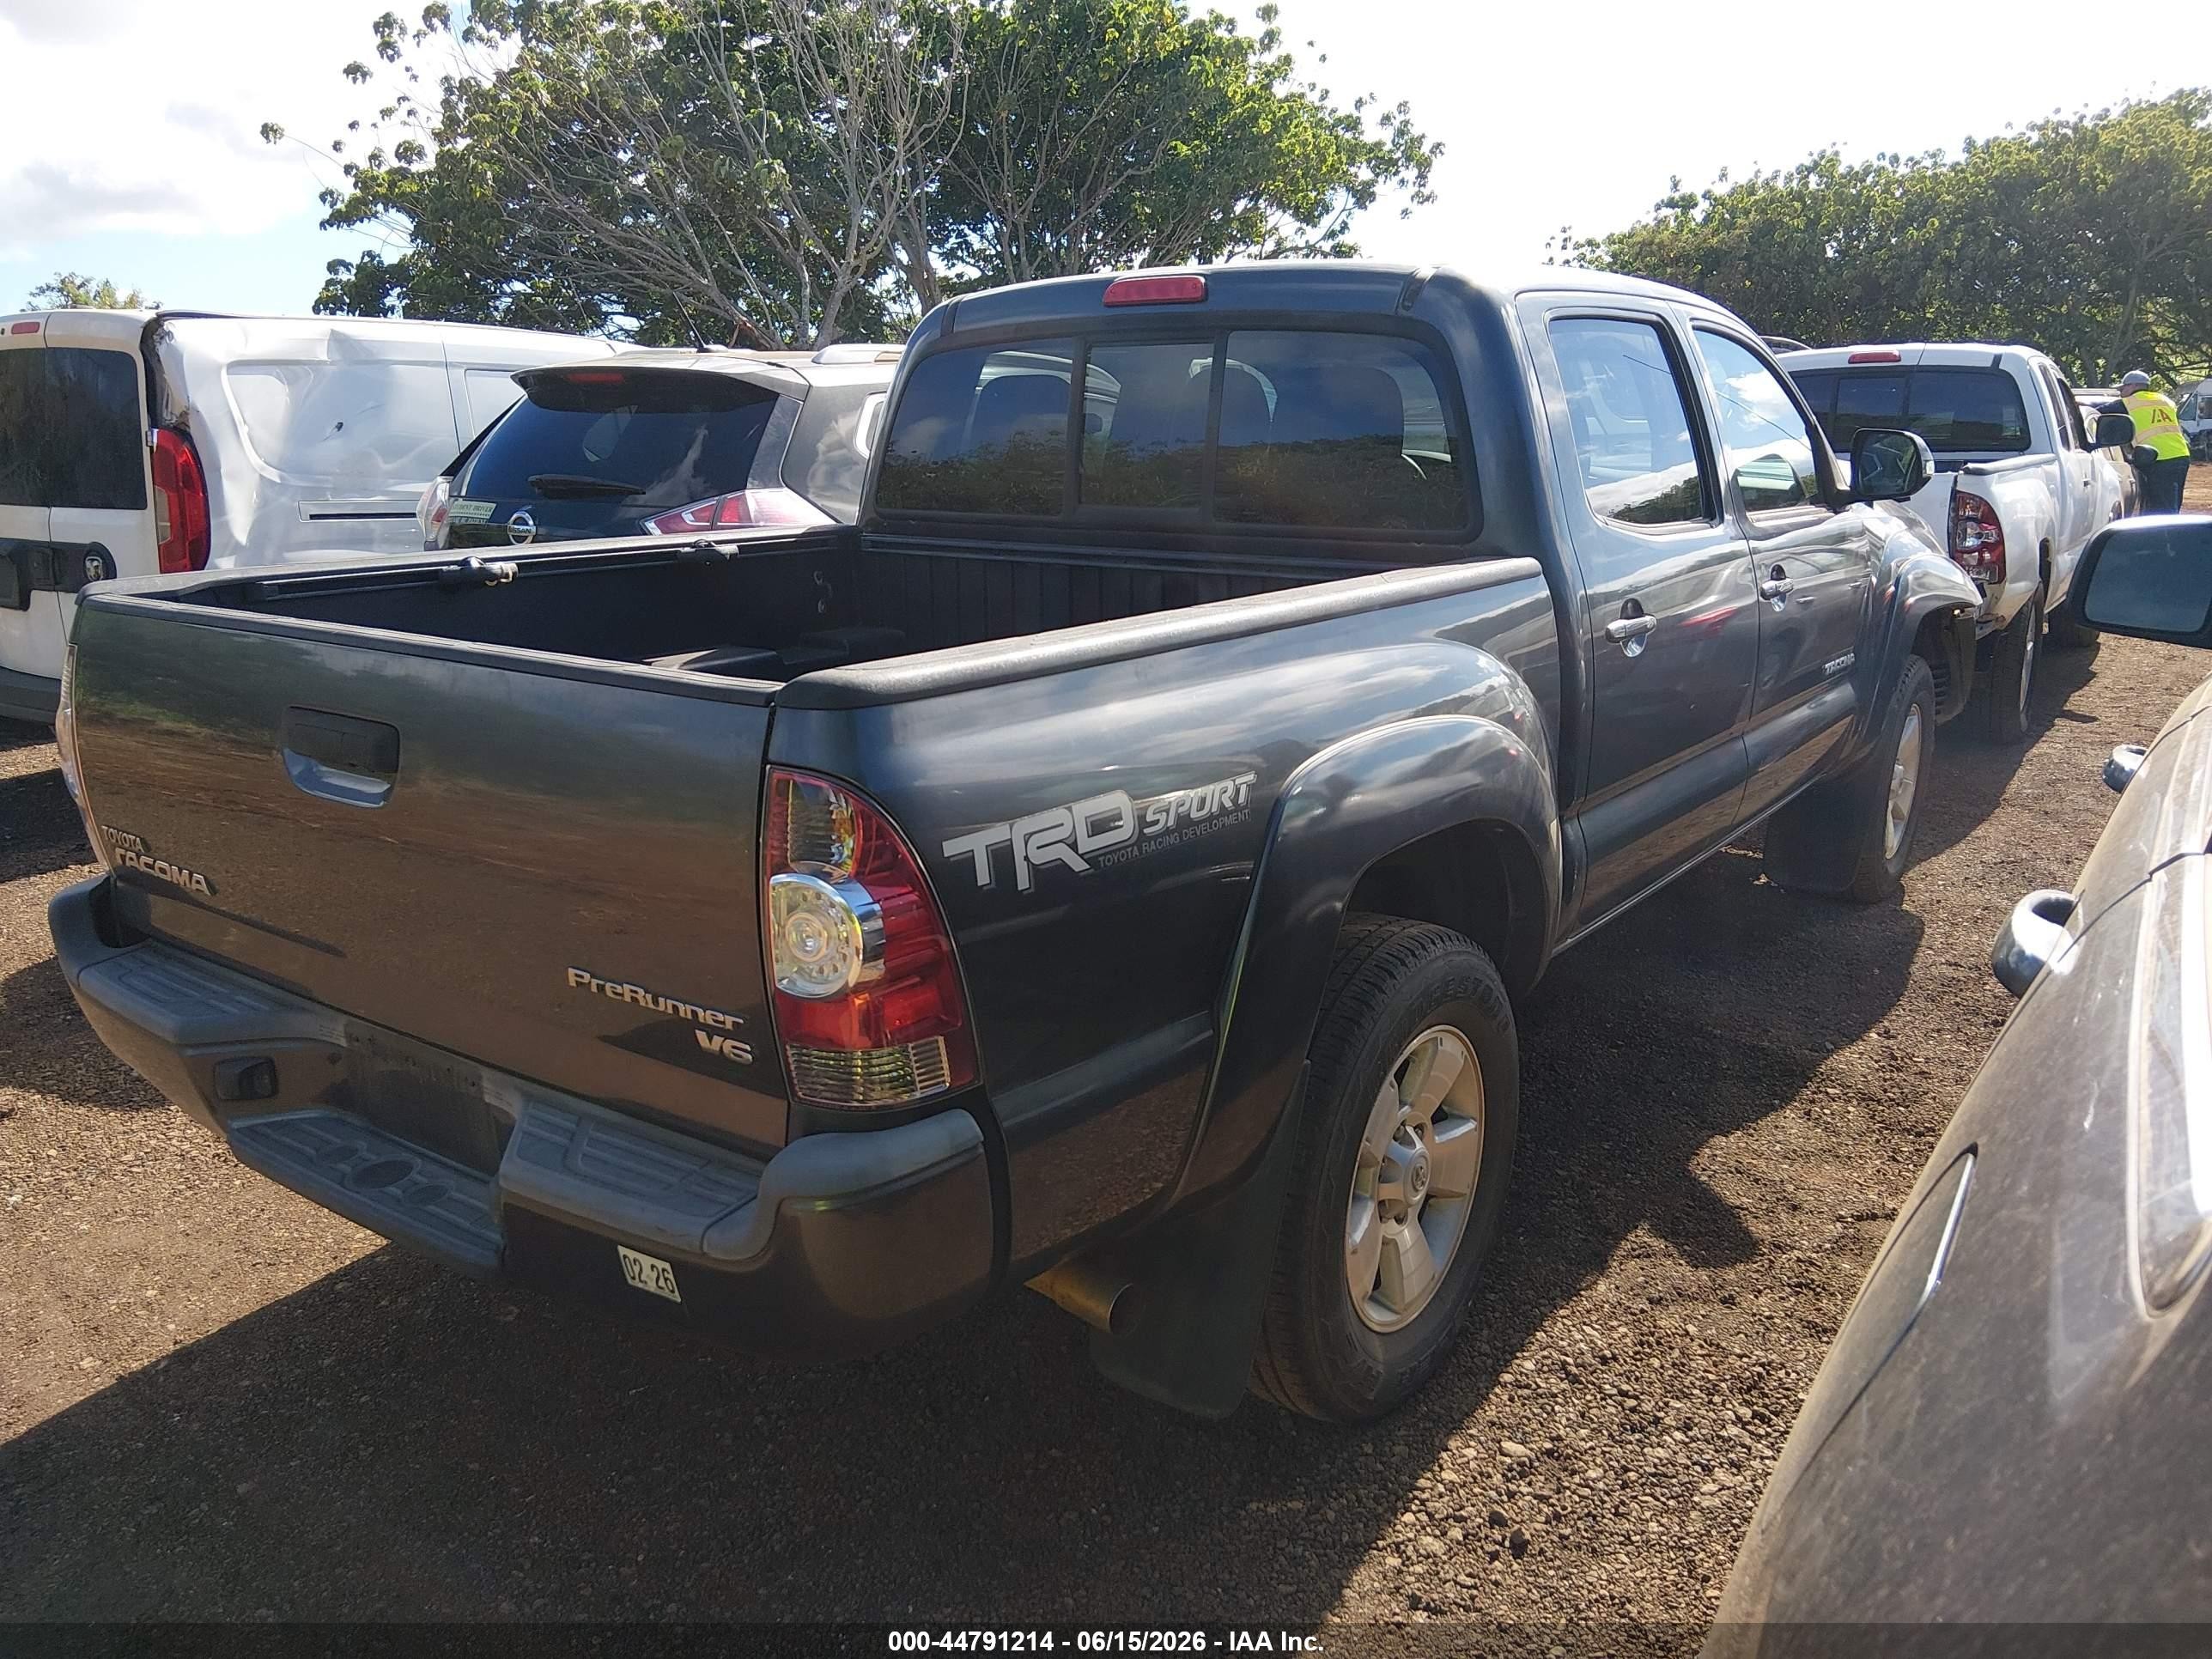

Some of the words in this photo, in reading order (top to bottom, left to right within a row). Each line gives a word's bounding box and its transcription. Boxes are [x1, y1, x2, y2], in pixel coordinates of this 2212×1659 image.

[101, 825, 145, 854] TOYOTA
[941, 789, 1138, 894] TRD
[1143, 770, 1258, 837] SPORT
[1097, 846, 1139, 868] TOYOTA
[1141, 831, 1180, 854] RACING
[1182, 809, 1251, 842] DEVELOPMENT
[114, 847, 212, 896] TACOMA
[567, 967, 744, 1031] PreRunner
[694, 1029, 754, 1066] V6
